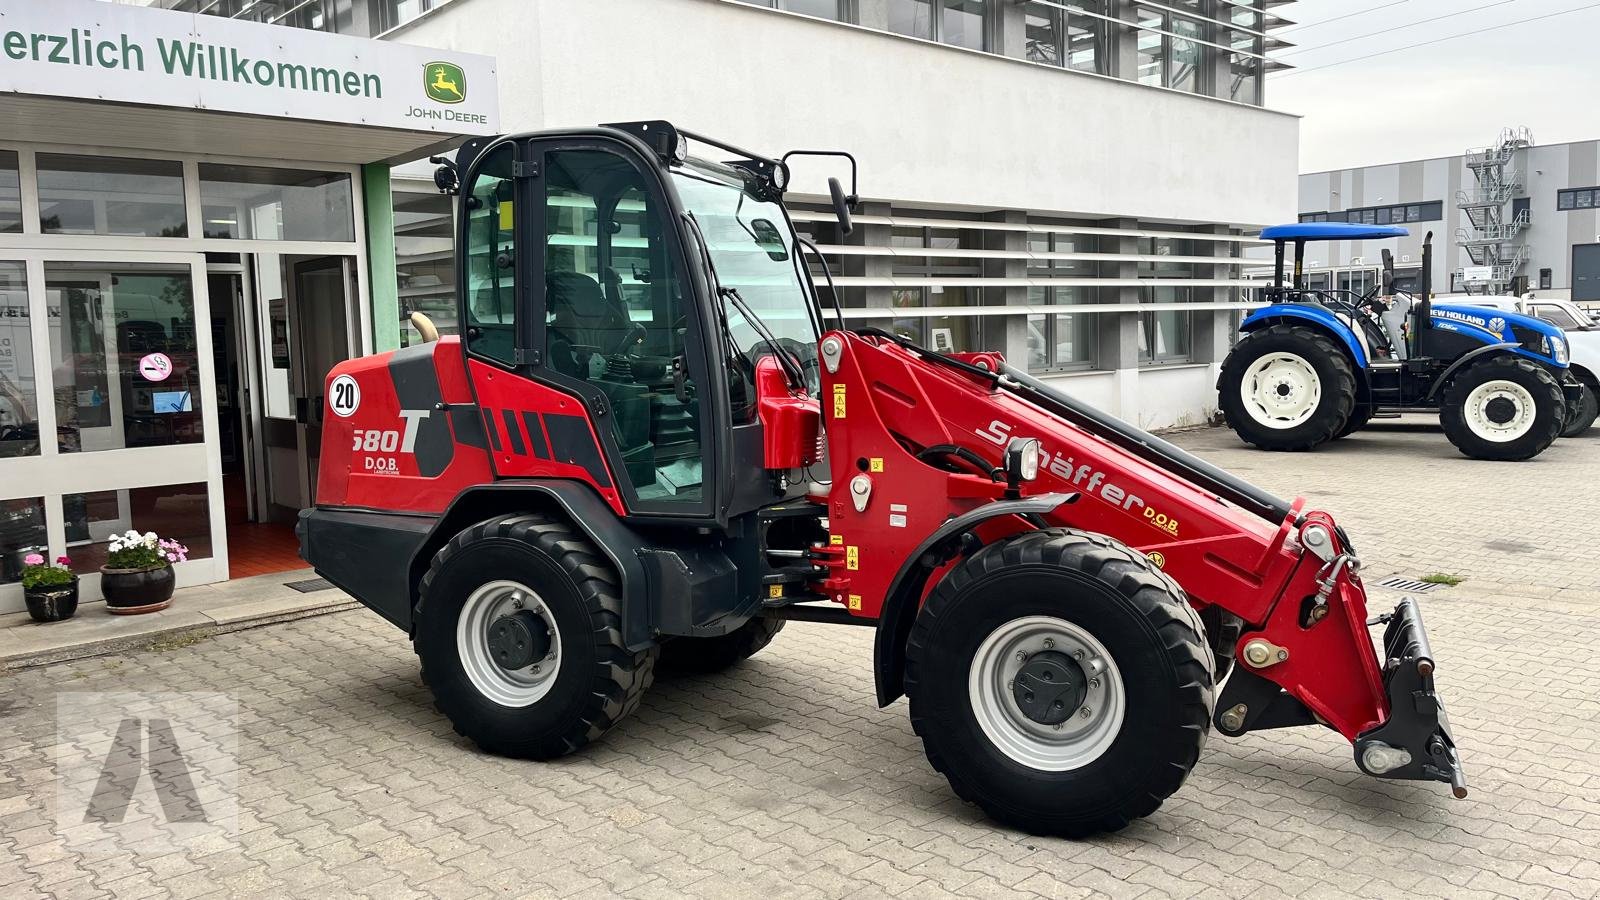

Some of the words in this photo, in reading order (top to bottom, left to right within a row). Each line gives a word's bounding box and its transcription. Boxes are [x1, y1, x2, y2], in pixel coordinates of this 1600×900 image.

[3, 28, 144, 71] erzlich
[156, 37, 383, 99] Willkommen
[405, 105, 442, 119] JOHN
[445, 109, 487, 124] DEERE
[1446, 311, 1486, 326] HOLLAND
[336, 383, 354, 408] 20
[365, 456, 399, 471] D.O.B.
[975, 420, 1145, 510] Shäffer
